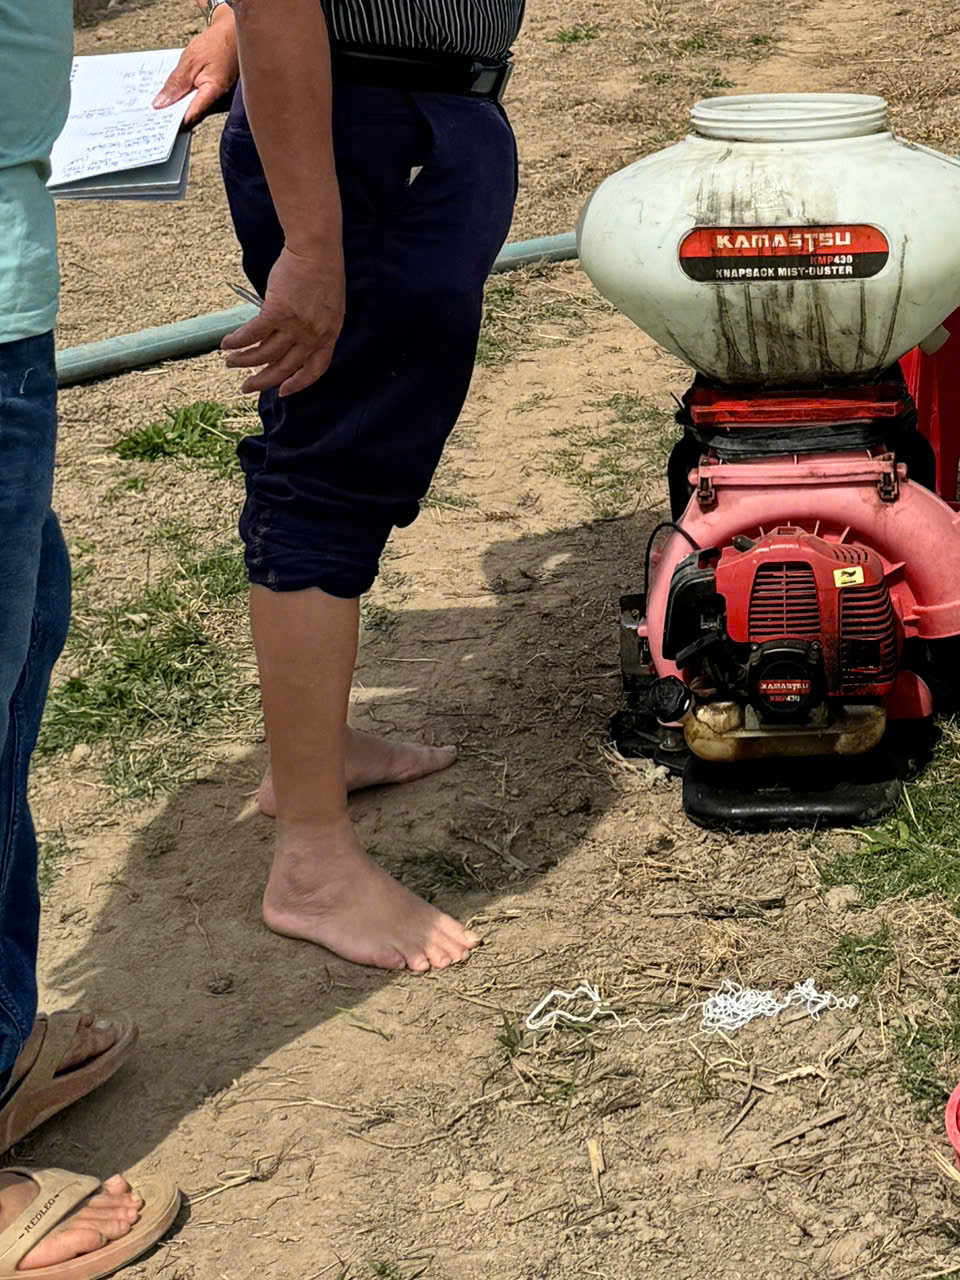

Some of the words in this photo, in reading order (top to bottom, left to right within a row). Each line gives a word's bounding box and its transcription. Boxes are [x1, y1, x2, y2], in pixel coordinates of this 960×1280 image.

[716, 231, 851, 253] KAMASTSU
[716, 267, 775, 279] KNAPSACK
[777, 265, 853, 278] MIST-DUSTER
